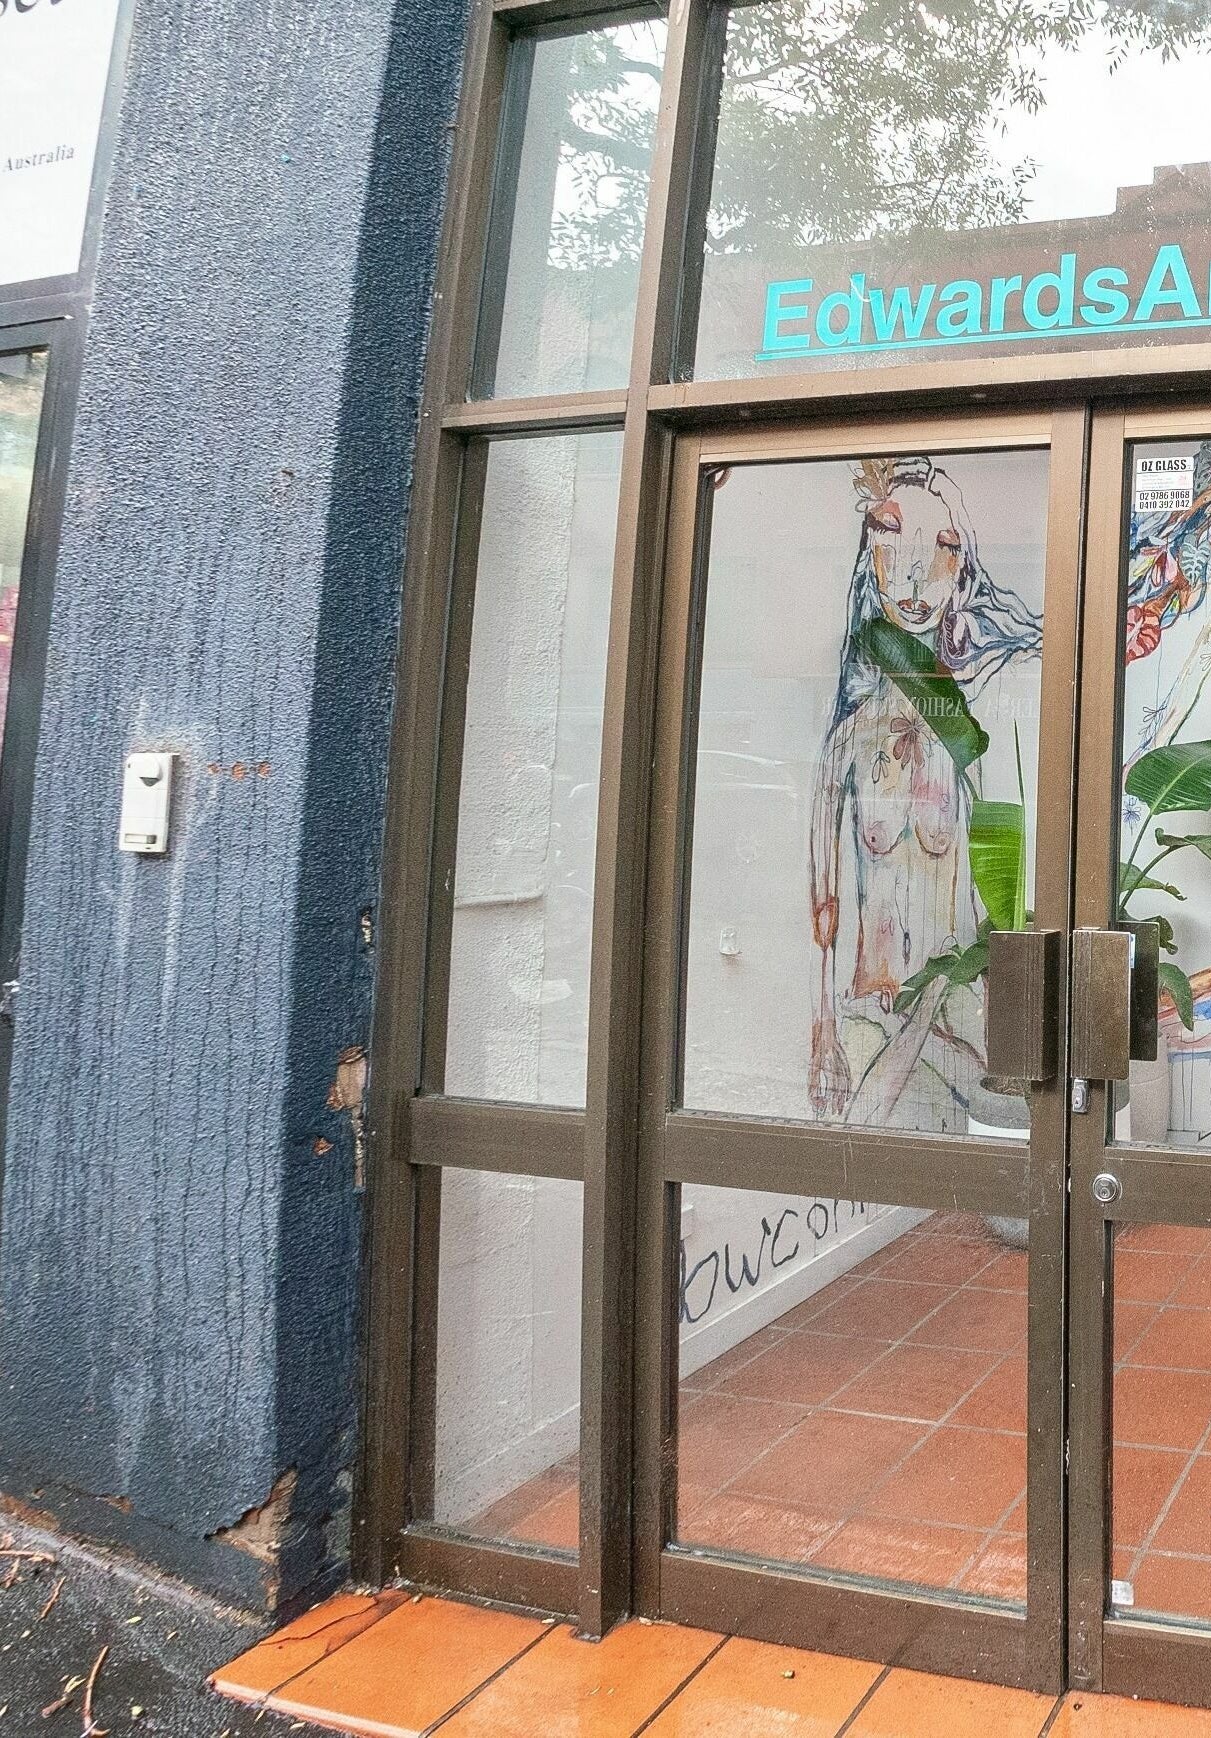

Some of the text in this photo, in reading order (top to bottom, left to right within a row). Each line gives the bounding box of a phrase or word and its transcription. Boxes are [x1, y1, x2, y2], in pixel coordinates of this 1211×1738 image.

[2, 144, 75, 172] Australia
[1141, 459, 1187, 472] OZ GLASS
[1139, 492, 1149, 501] 02
[1139, 501, 1157, 509] 0410
